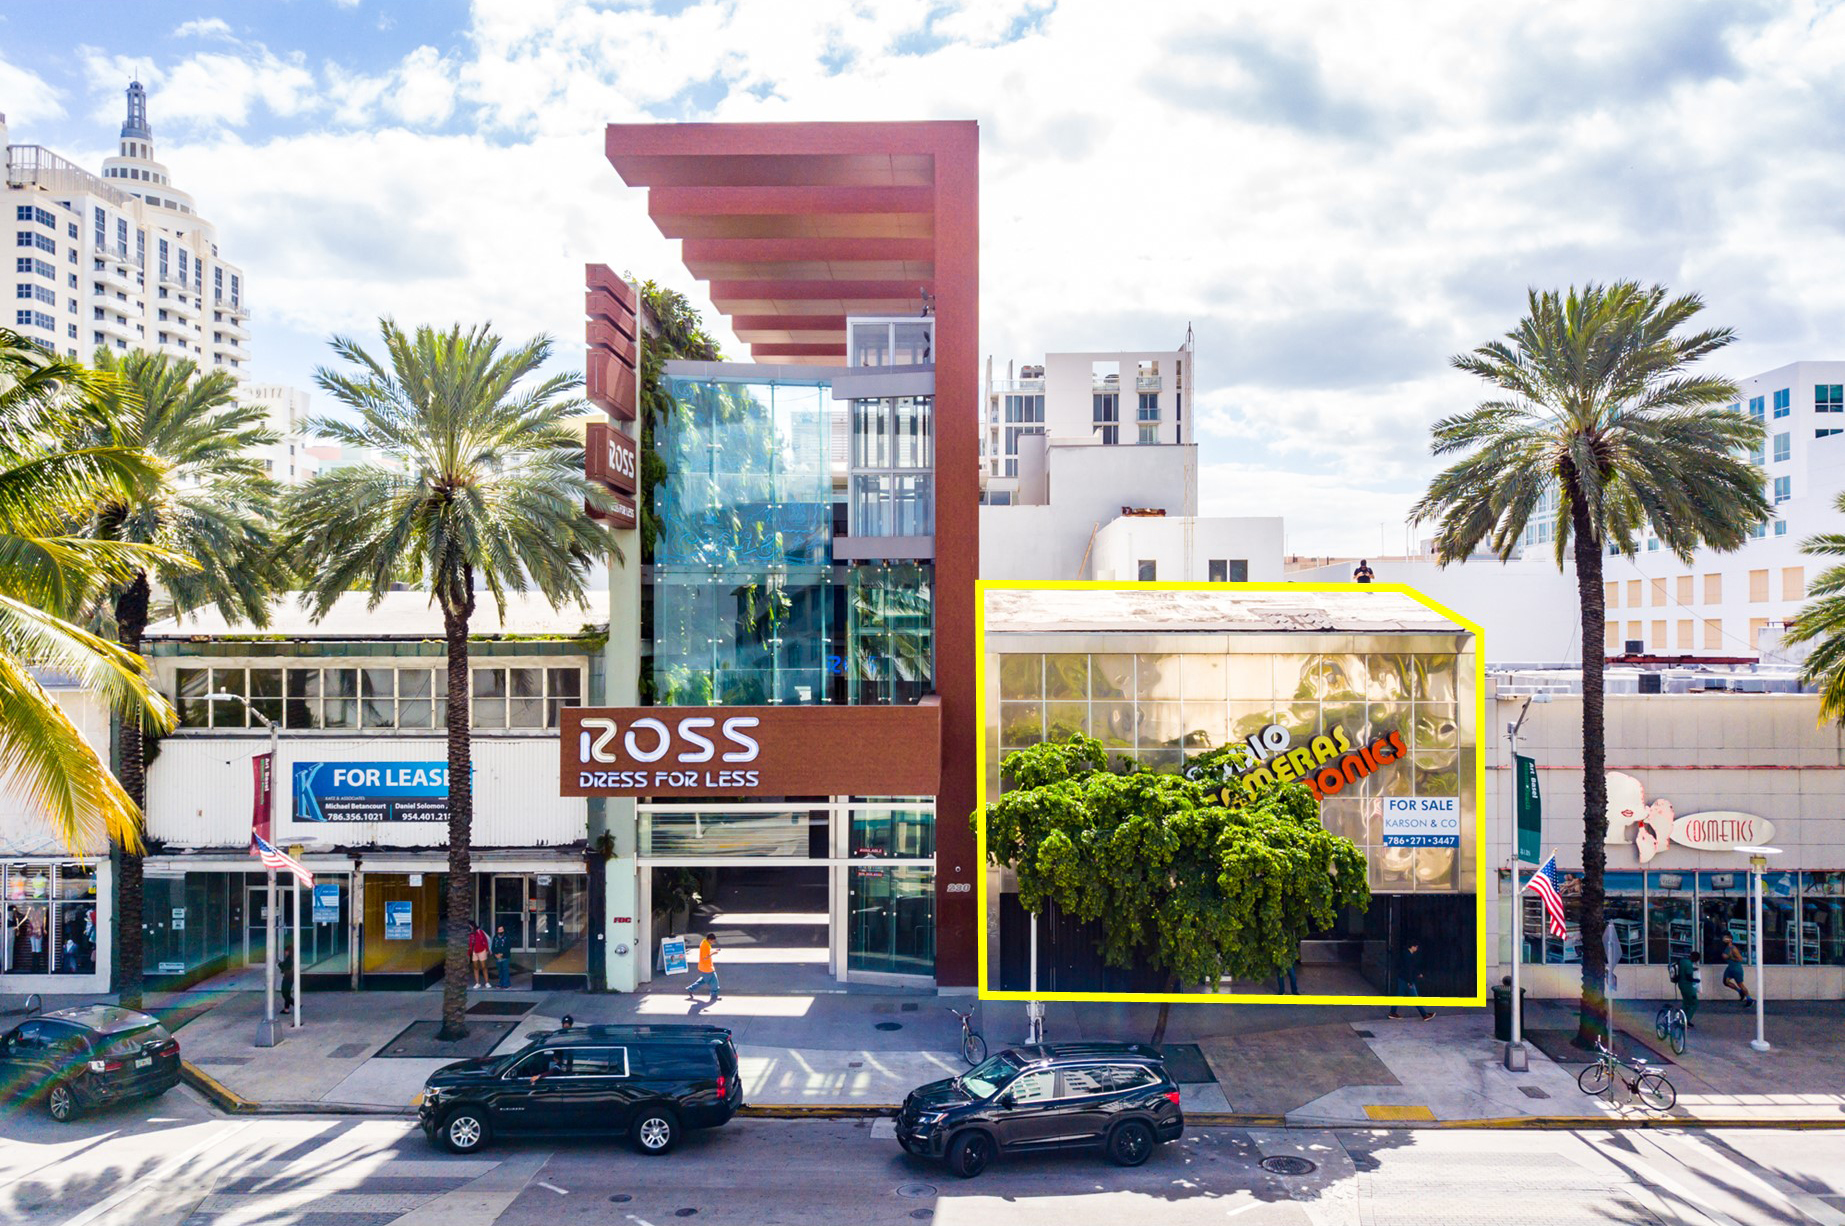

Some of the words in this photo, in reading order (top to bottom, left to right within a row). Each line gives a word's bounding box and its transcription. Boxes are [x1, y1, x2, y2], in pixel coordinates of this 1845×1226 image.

[608, 439, 635, 479] ROSS
[579, 716, 760, 763] ROSS
[333, 768, 381, 787] FOR
[579, 770, 648, 788] DRESS
[655, 770, 699, 788] FOR
[705, 770, 760, 787] LESS
[1530, 777, 1539, 799] Basel
[1389, 799, 1417, 811] FOR
[1421, 799, 1454, 811] SALE
[327, 813, 384, 821] 786.356.1021
[1385, 818, 1428, 828] KARSON
[1430, 818, 1439, 828] &
[1440, 818, 1458, 828] CO
[1686, 819, 1753, 843] COSMETICS
